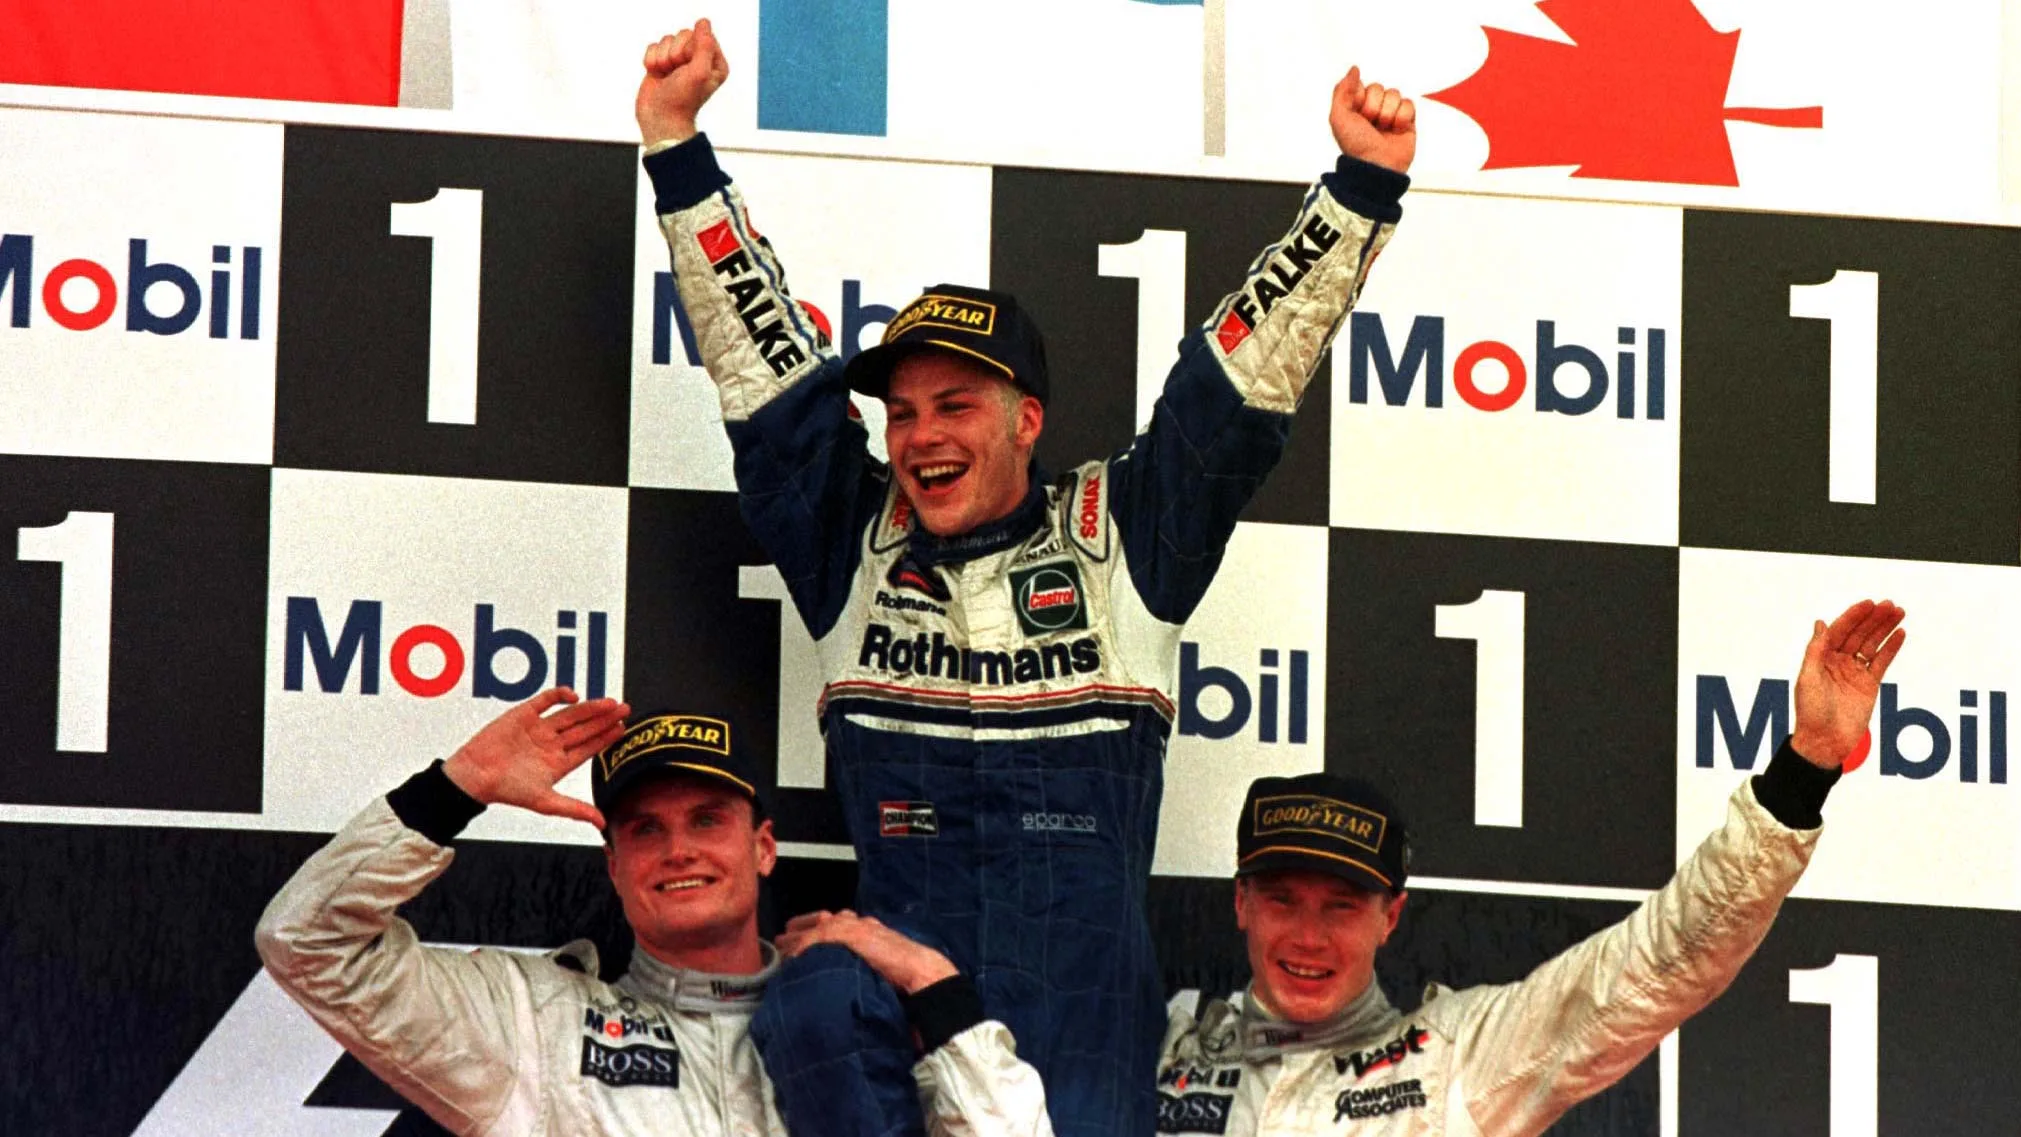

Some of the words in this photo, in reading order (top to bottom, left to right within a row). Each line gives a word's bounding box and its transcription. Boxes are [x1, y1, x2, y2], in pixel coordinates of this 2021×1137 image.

[390, 187, 483, 425] 1
[713, 249, 806, 379] FALKE
[1232, 213, 1342, 332] FALKE
[1098, 228, 1187, 437] 1
[1348, 311, 1666, 421] Mobil
[1789, 269, 1879, 505] 1
[1080, 475, 1100, 539] SONAX
[18, 510, 114, 753] 1
[283, 596, 608, 702] Mobil
[1029, 583, 1075, 609] Castrol
[858, 622, 1102, 686] Rothmans
[1178, 641, 1308, 744] bil
[1434, 589, 1525, 829] 1
[1695, 674, 2008, 785] Mbil
[584, 1007, 649, 1038] Mobil
[590, 1044, 672, 1074] BOSS
[1789, 953, 1879, 1137] 1
